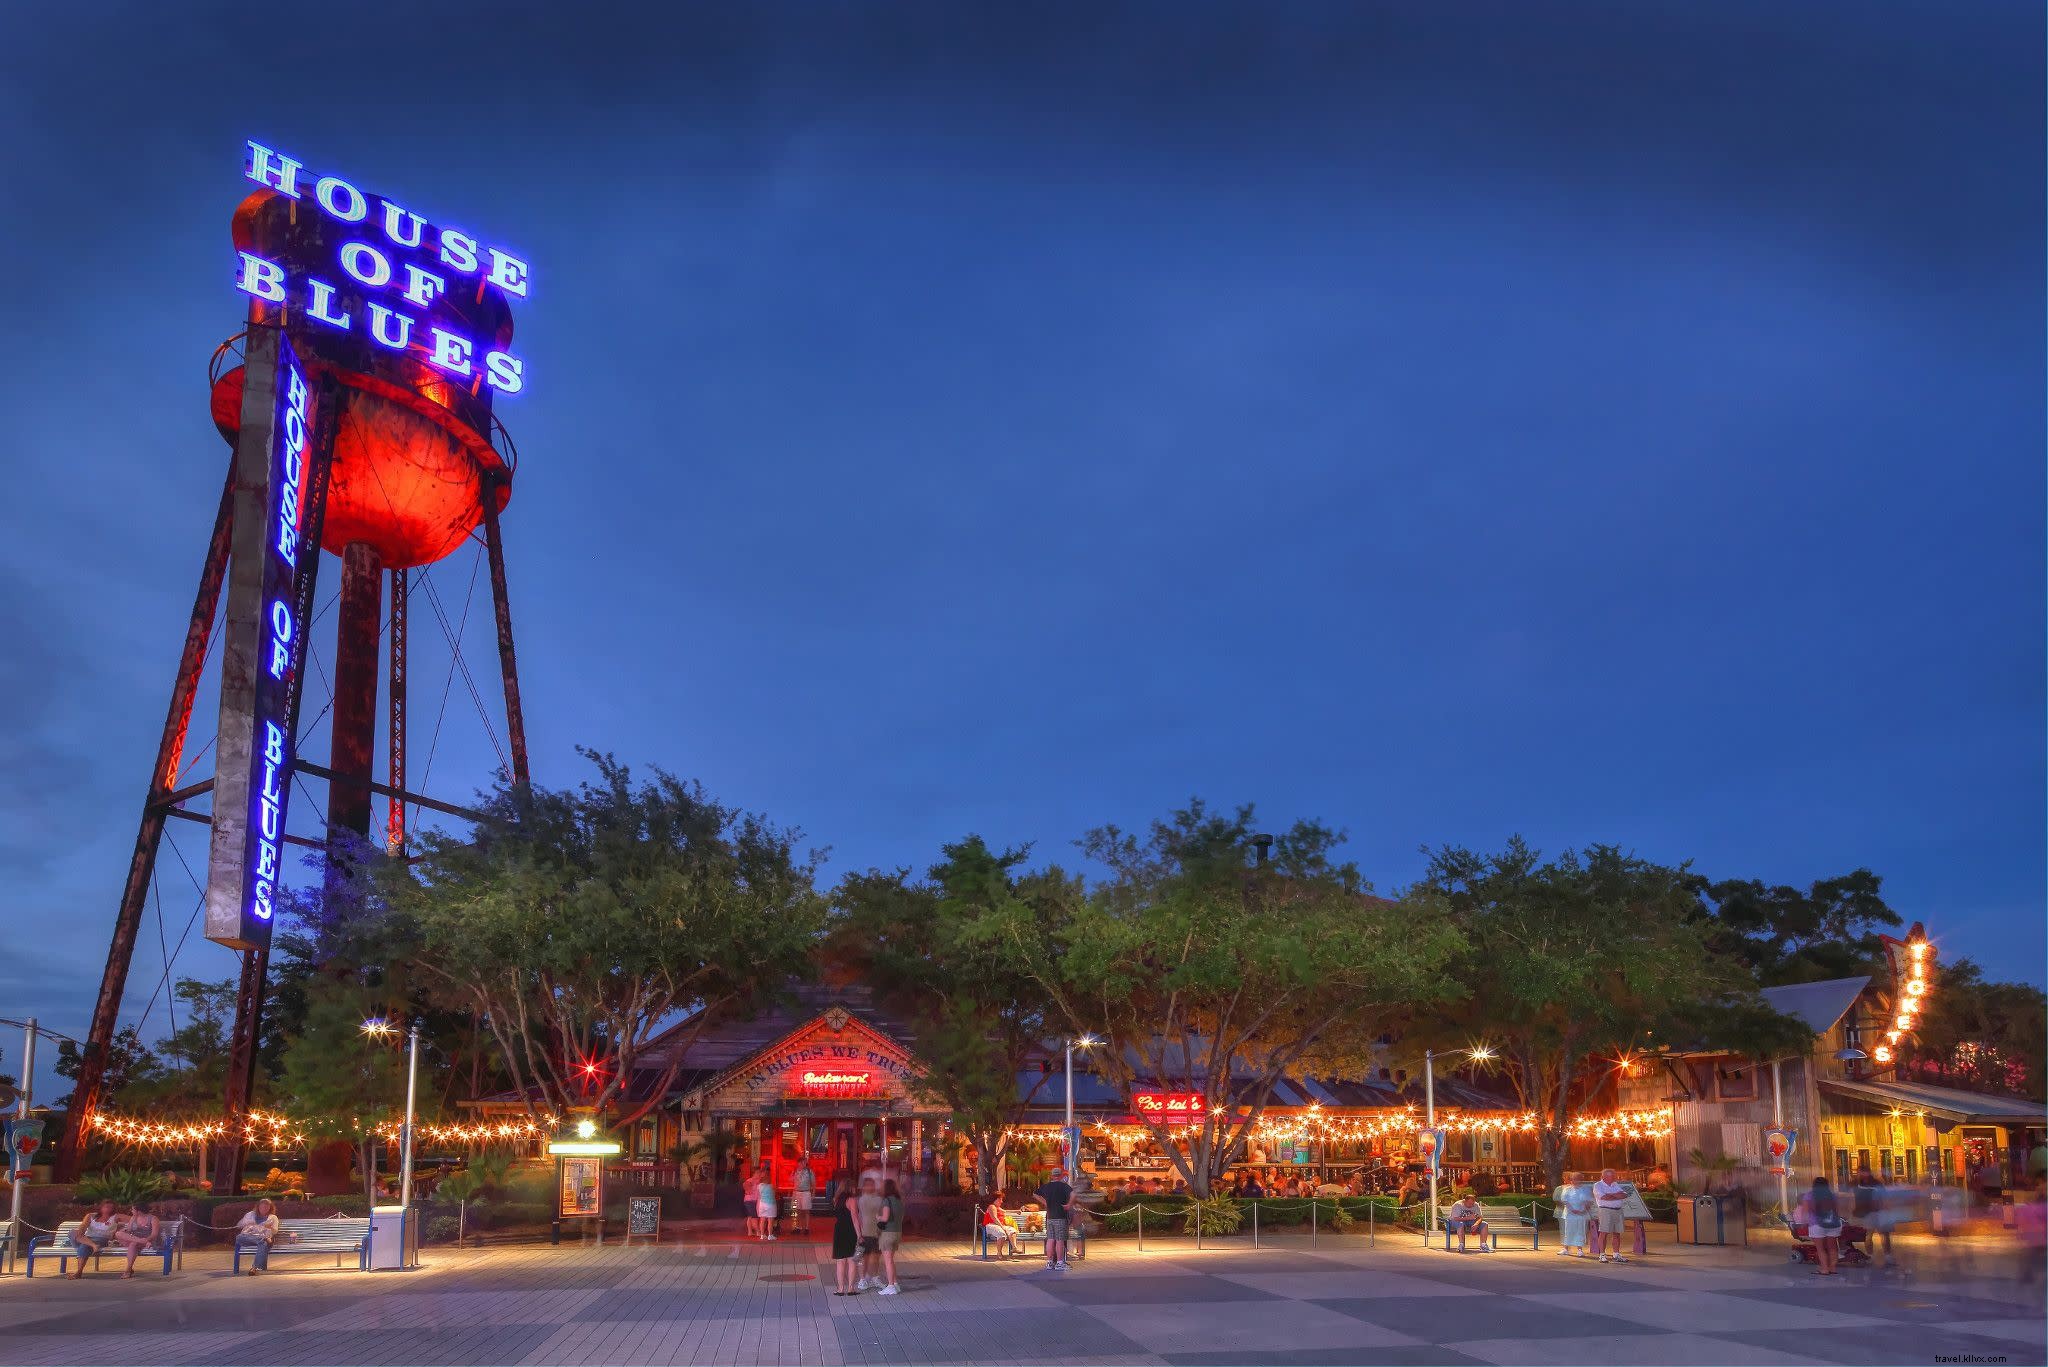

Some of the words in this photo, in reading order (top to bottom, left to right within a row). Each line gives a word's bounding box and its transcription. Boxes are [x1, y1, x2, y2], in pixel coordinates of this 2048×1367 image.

[245, 139, 529, 298] HOUSE
[340, 242, 445, 307] OF
[235, 250, 524, 393] BLUES
[278, 363, 307, 568] HOUSE
[271, 600, 292, 681] OF
[254, 720, 283, 920] BLUES
[745, 1072, 766, 1090] IN
[767, 1047, 823, 1075] BLUES
[831, 1046, 859, 1058] WE
[866, 1051, 913, 1081] TRUS
[802, 1072, 869, 1084] Restaurant
[1138, 1096, 1201, 1110] Coctais
